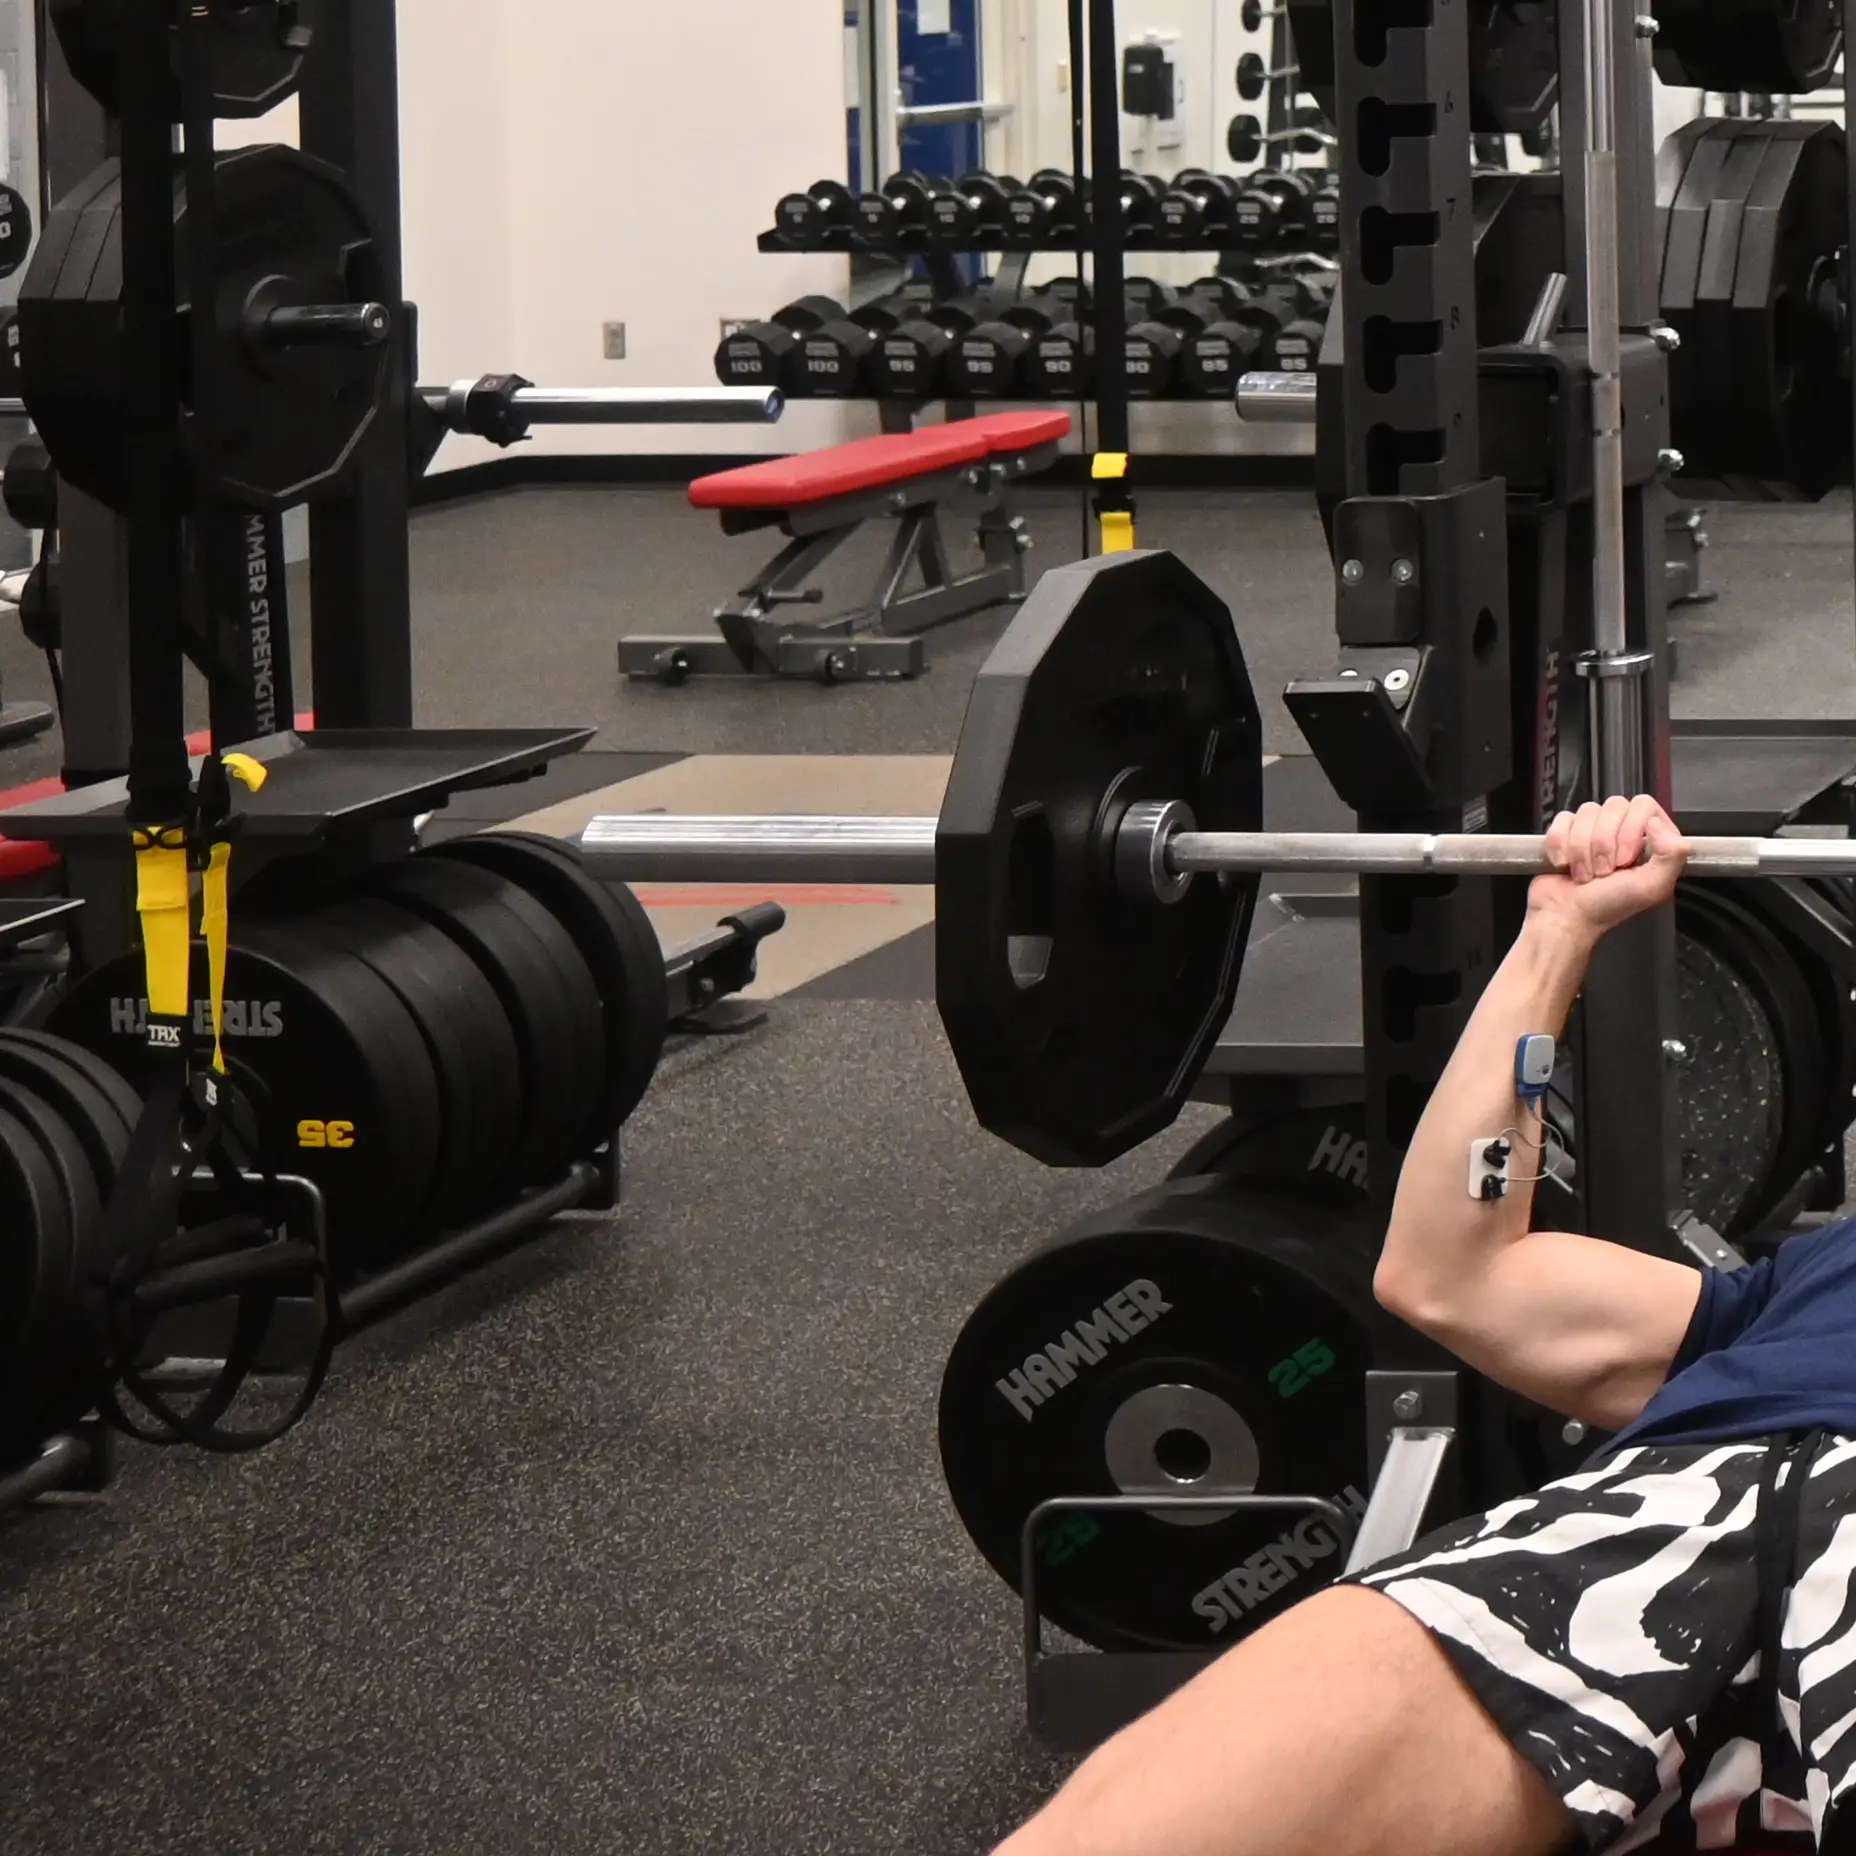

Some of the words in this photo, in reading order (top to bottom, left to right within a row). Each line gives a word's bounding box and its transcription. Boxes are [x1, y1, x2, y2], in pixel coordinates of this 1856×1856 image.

[730, 360, 763, 374] 100
[807, 360, 840, 374] 100
[296, 1118, 355, 1148] 35
[995, 1277, 1175, 1423] HAMMER
[1267, 1337, 1336, 1399] 25
[1191, 1485, 1370, 1634] STRENGH
